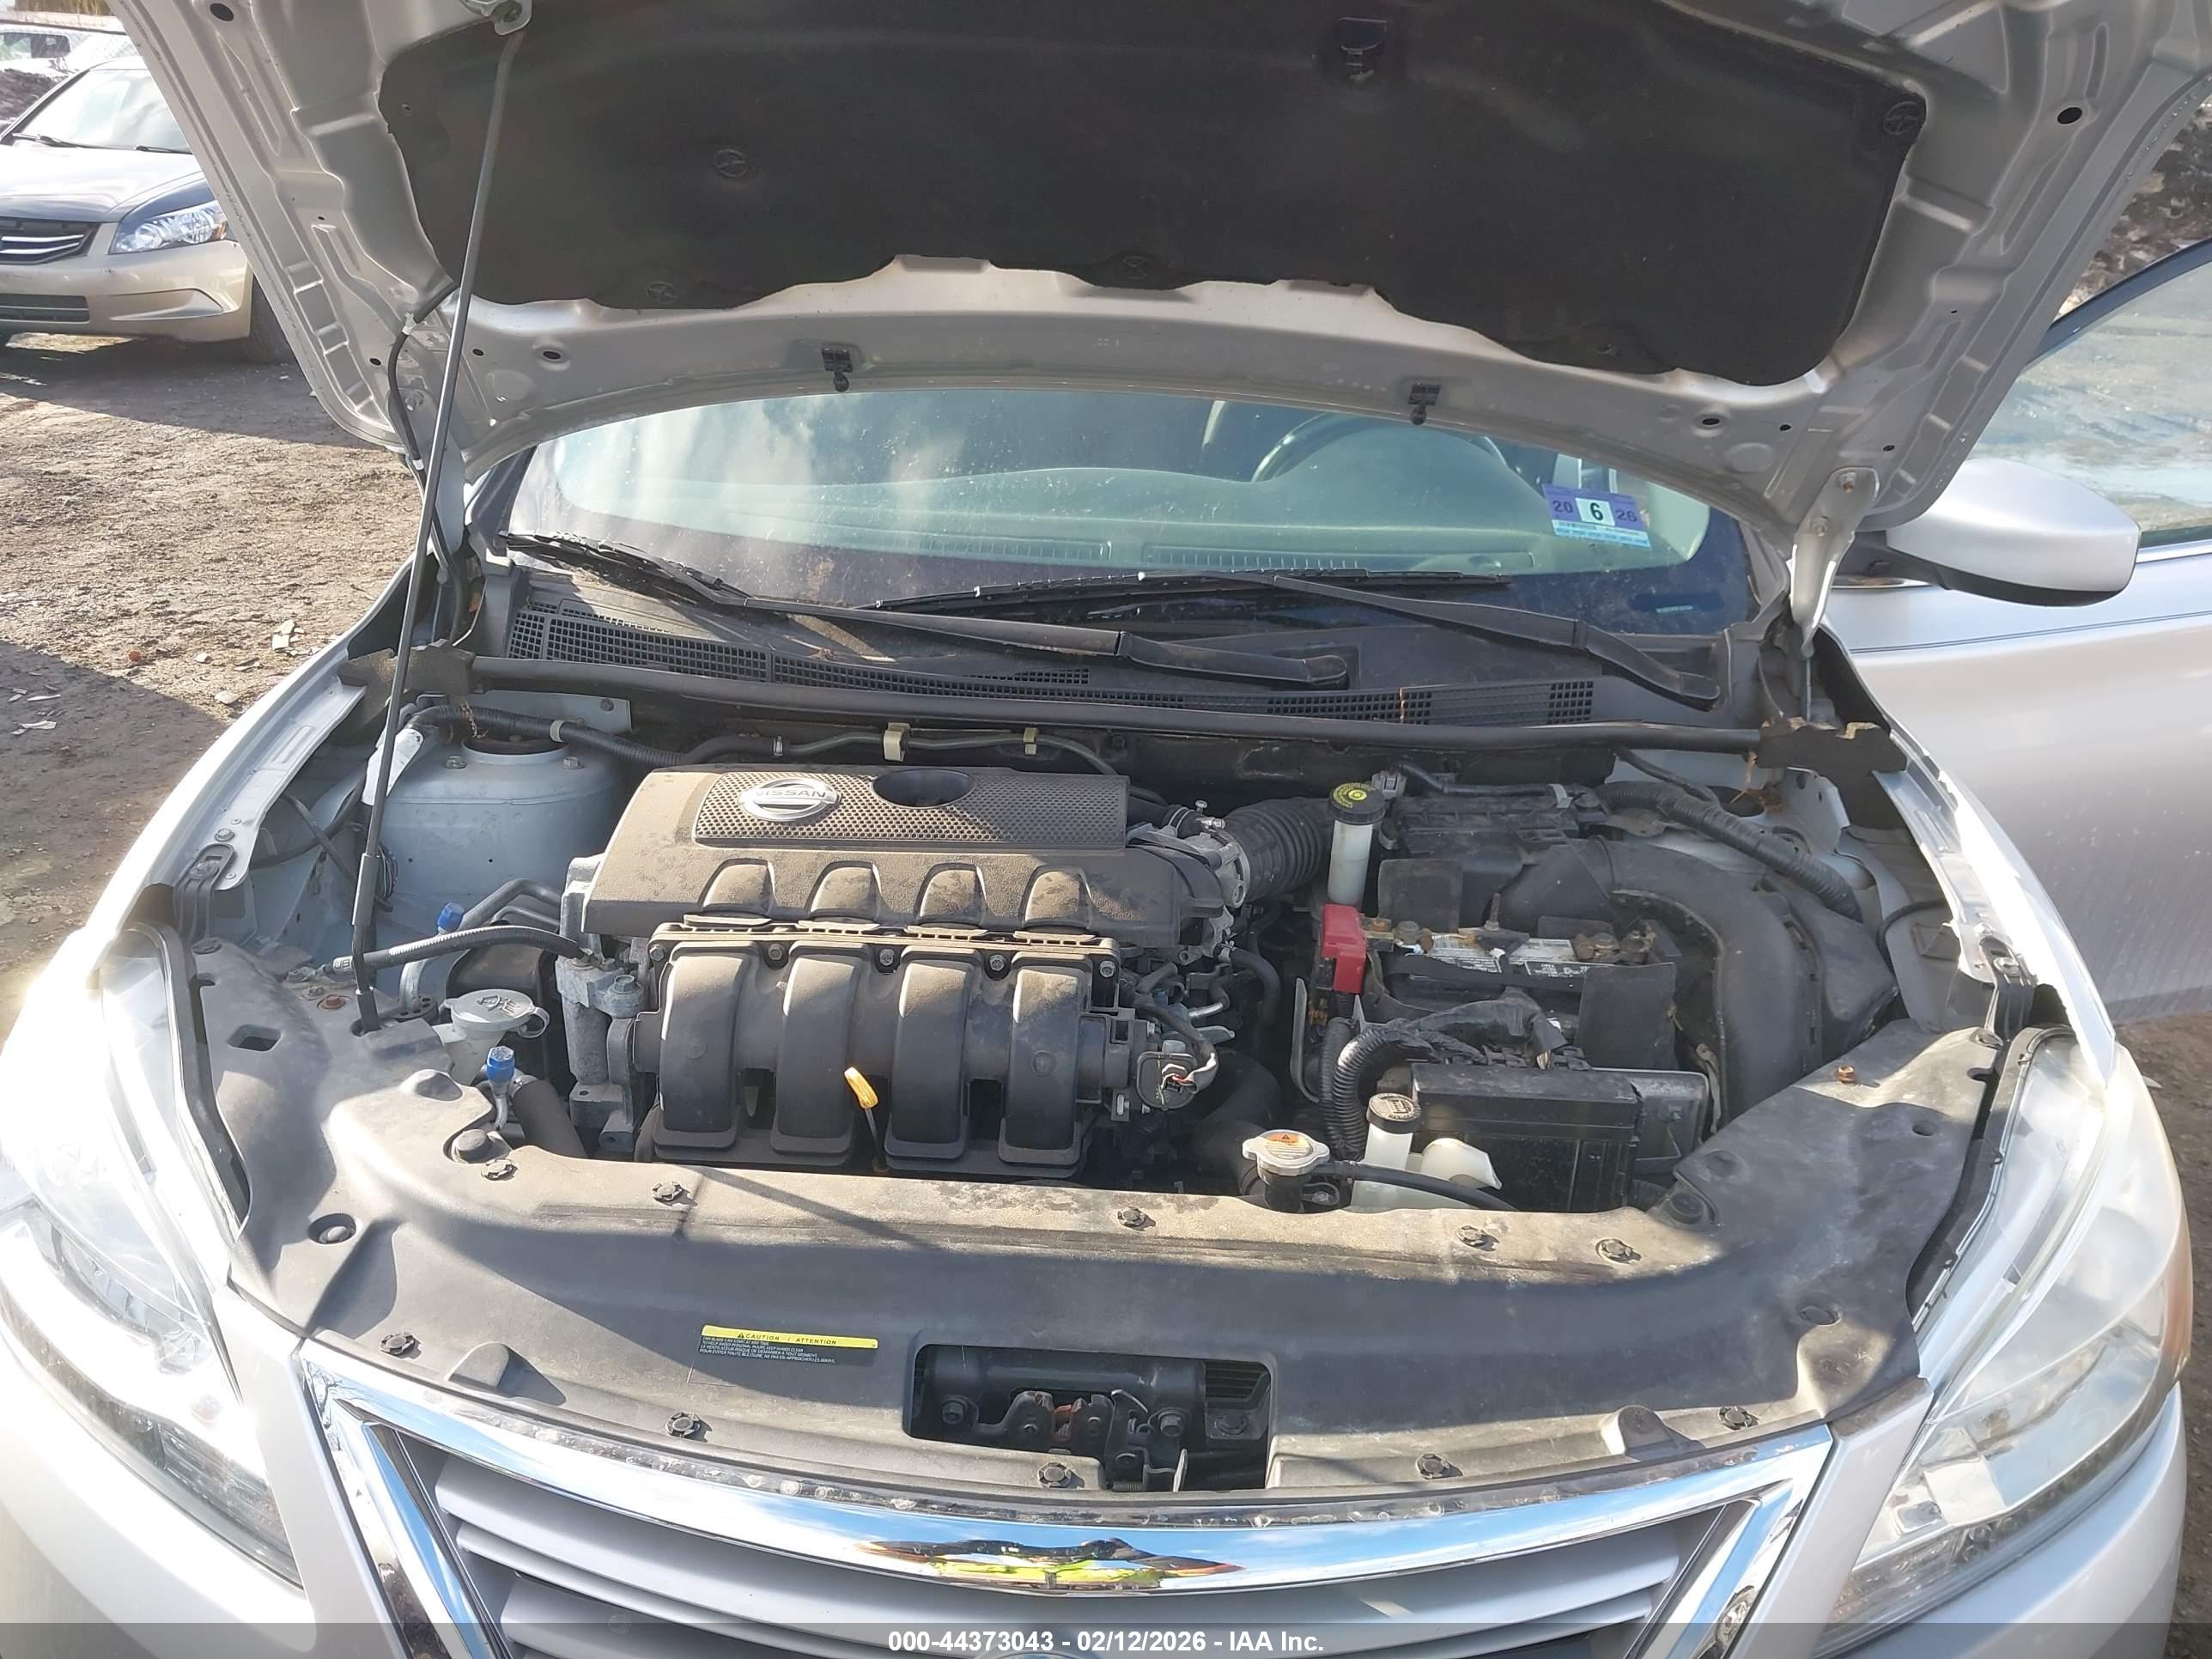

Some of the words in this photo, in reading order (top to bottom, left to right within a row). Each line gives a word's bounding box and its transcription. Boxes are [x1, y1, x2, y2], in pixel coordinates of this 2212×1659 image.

[1552, 500, 1573, 514] 20
[1589, 502, 1604, 521] 6
[755, 789, 826, 799] NISSAN
[745, 1333, 780, 1341] CAUTION
[795, 1337, 837, 1346] ATTENTION
